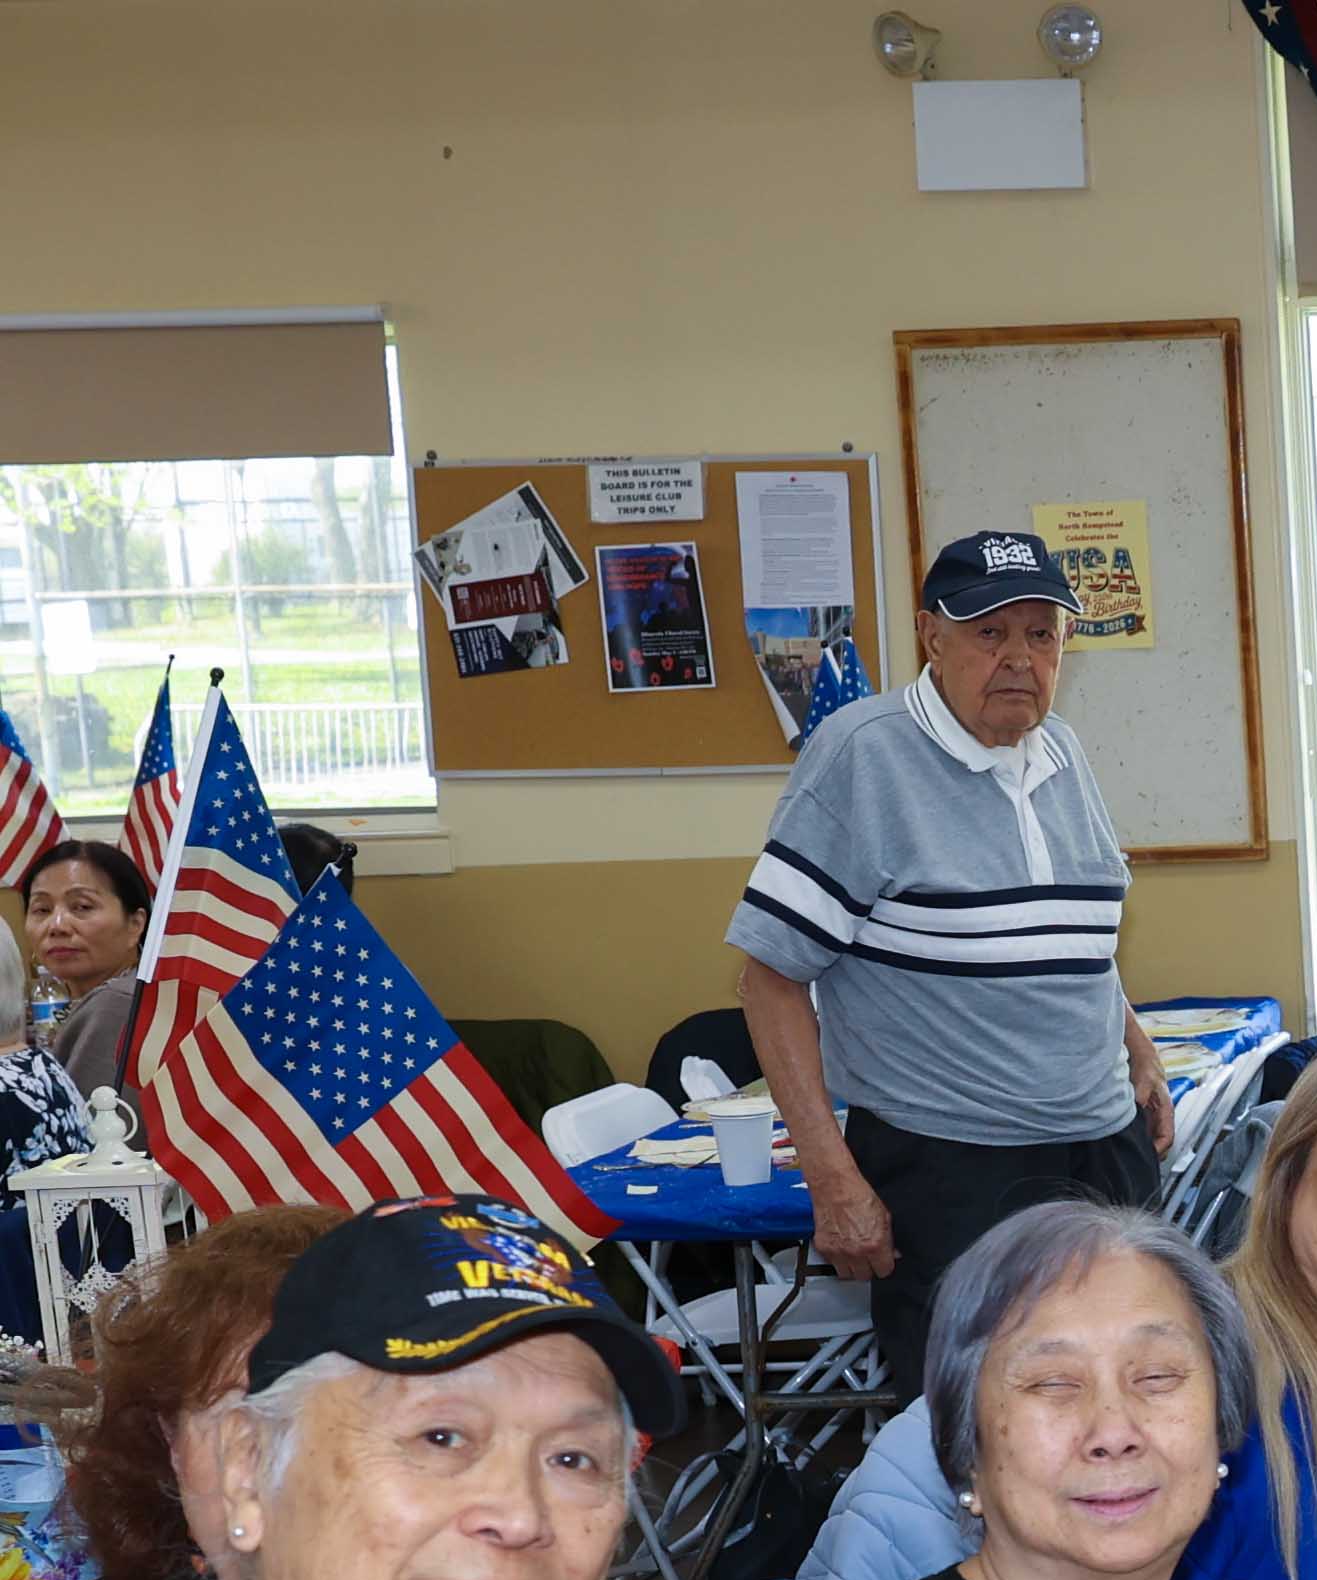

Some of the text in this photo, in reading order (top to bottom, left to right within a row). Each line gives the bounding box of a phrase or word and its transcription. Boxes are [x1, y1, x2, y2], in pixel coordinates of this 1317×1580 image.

[632, 468, 681, 477] BULLETIN
[601, 480, 693, 490] BOARD IS FOR THE
[610, 492, 682, 503] LEISURE CLUB
[617, 505, 676, 515] TRIPS ONLY
[982, 545, 1037, 568] 1932
[1050, 547, 1141, 595] USA
